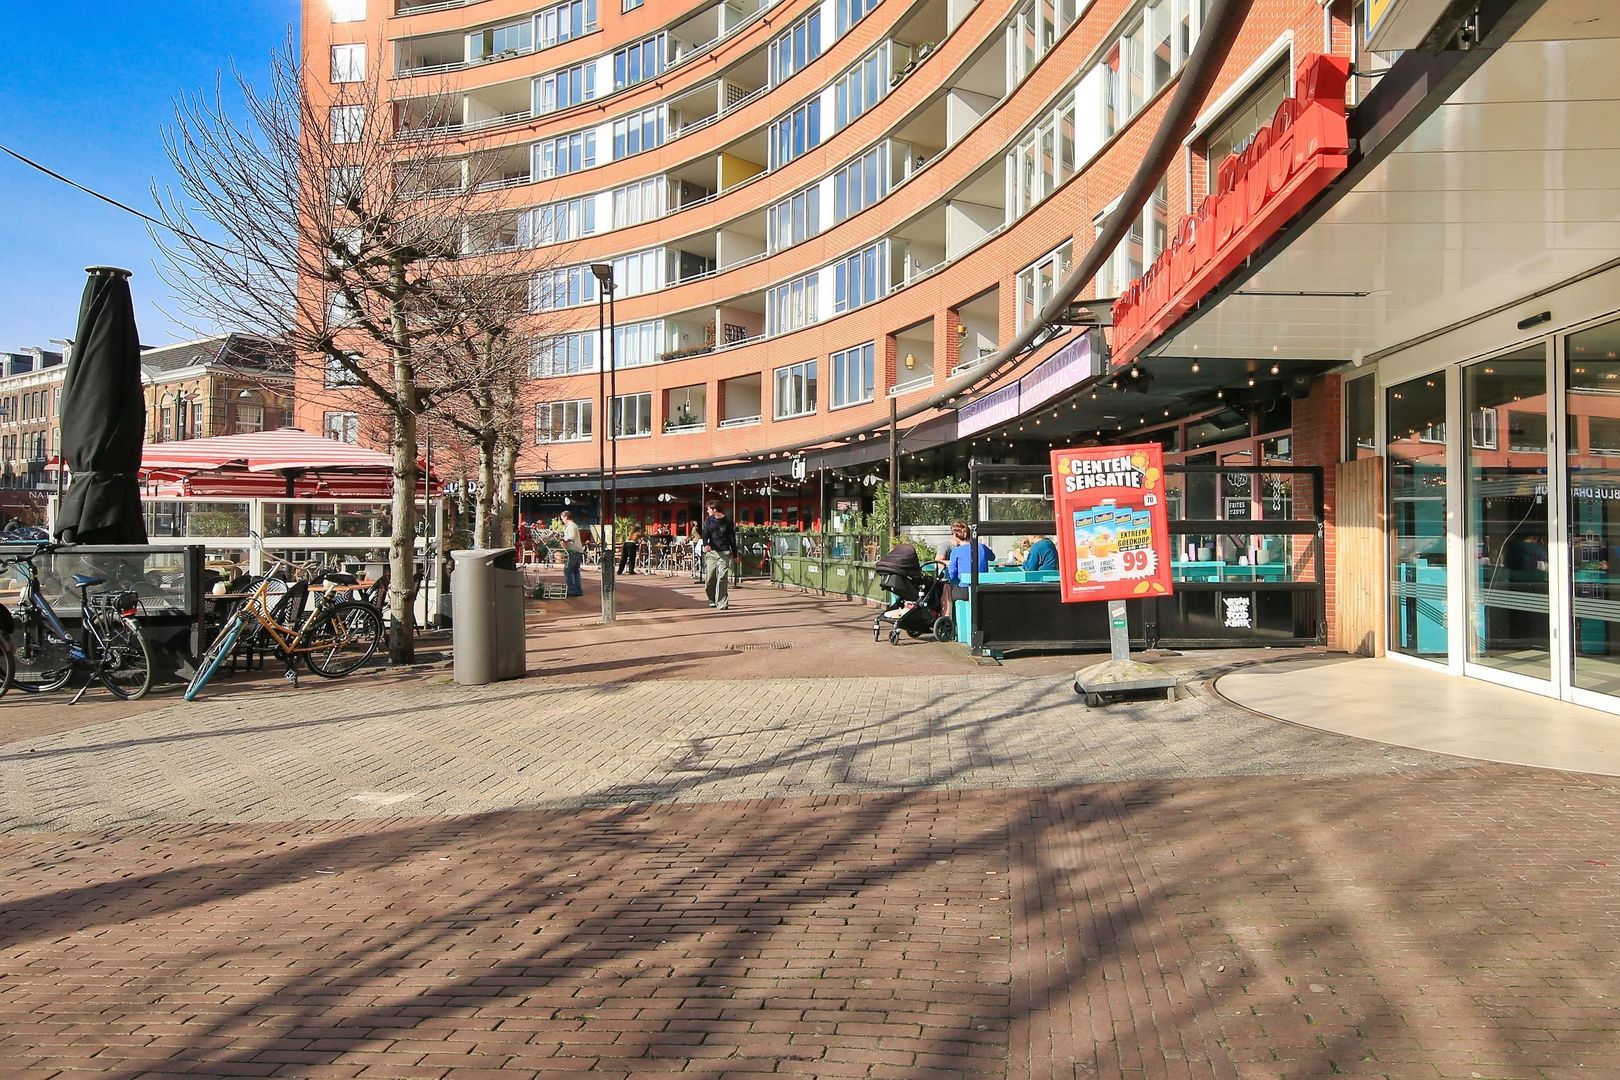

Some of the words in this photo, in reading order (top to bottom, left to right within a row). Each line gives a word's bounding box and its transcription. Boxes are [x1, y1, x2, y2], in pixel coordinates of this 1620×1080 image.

[1071, 456, 1132, 475] CENTEN
[1065, 471, 1141, 493] SENSATIE
[1120, 528, 1148, 539] EXTREEM
[1117, 536, 1150, 547] GOEDKOOP
[1122, 550, 1148, 571] 99
[1222, 597, 1250, 607] VEGAN
[1226, 611, 1250, 620] FOOD
